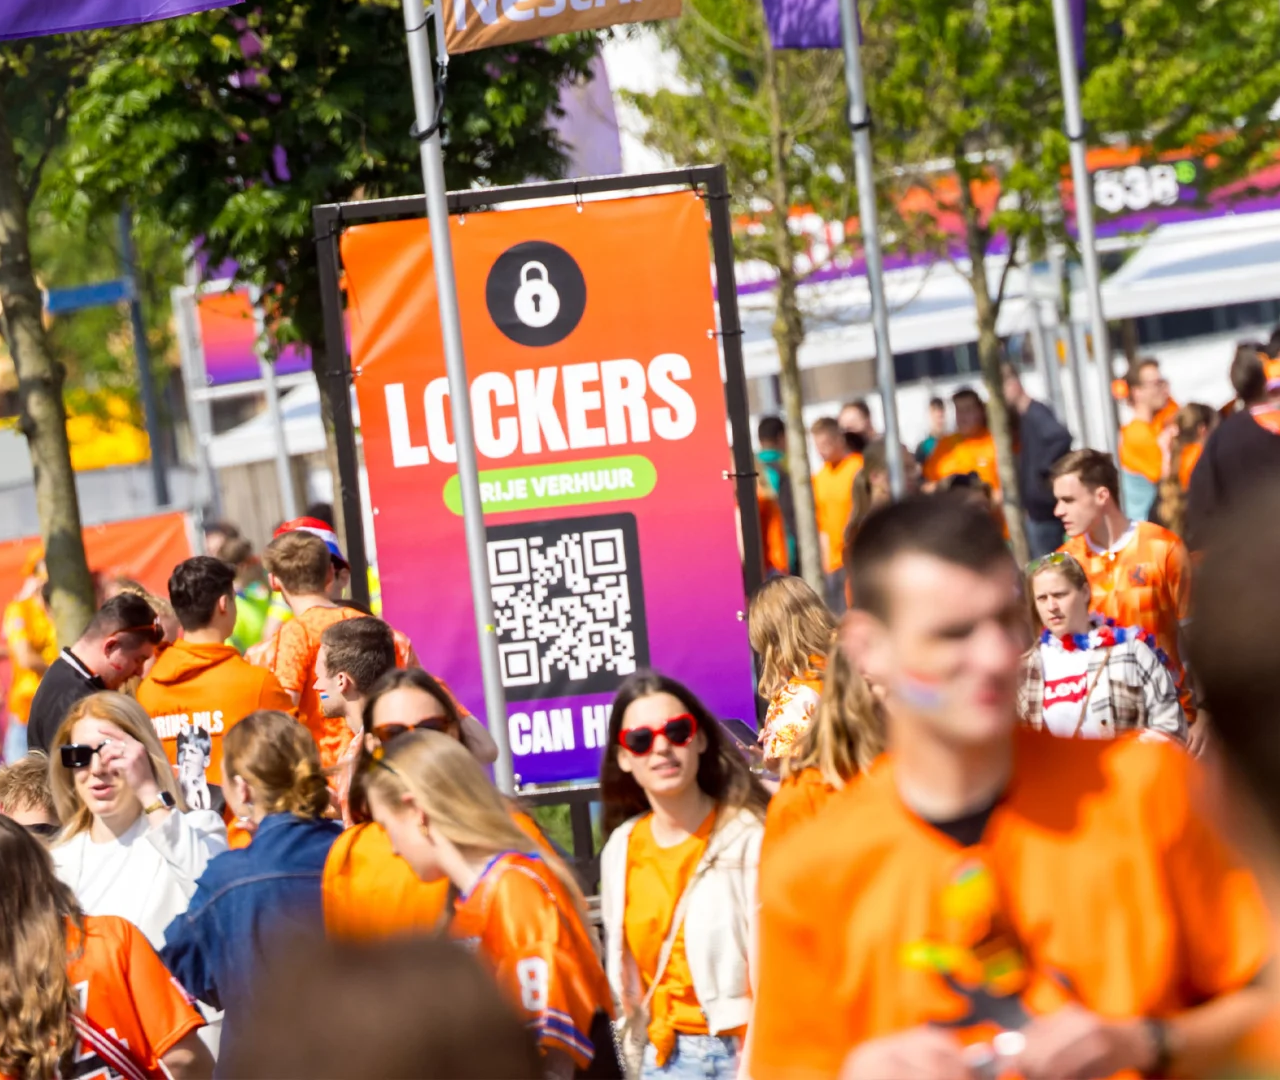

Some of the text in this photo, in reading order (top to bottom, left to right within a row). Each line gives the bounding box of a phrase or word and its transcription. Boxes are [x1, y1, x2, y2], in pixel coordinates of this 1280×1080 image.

[1093, 165, 1179, 213] 538
[384, 353, 698, 468] LOCKERS
[479, 467, 635, 503] RIJE VERHUUR
[192, 709, 224, 735] PILS
[508, 708, 575, 756] CAN
